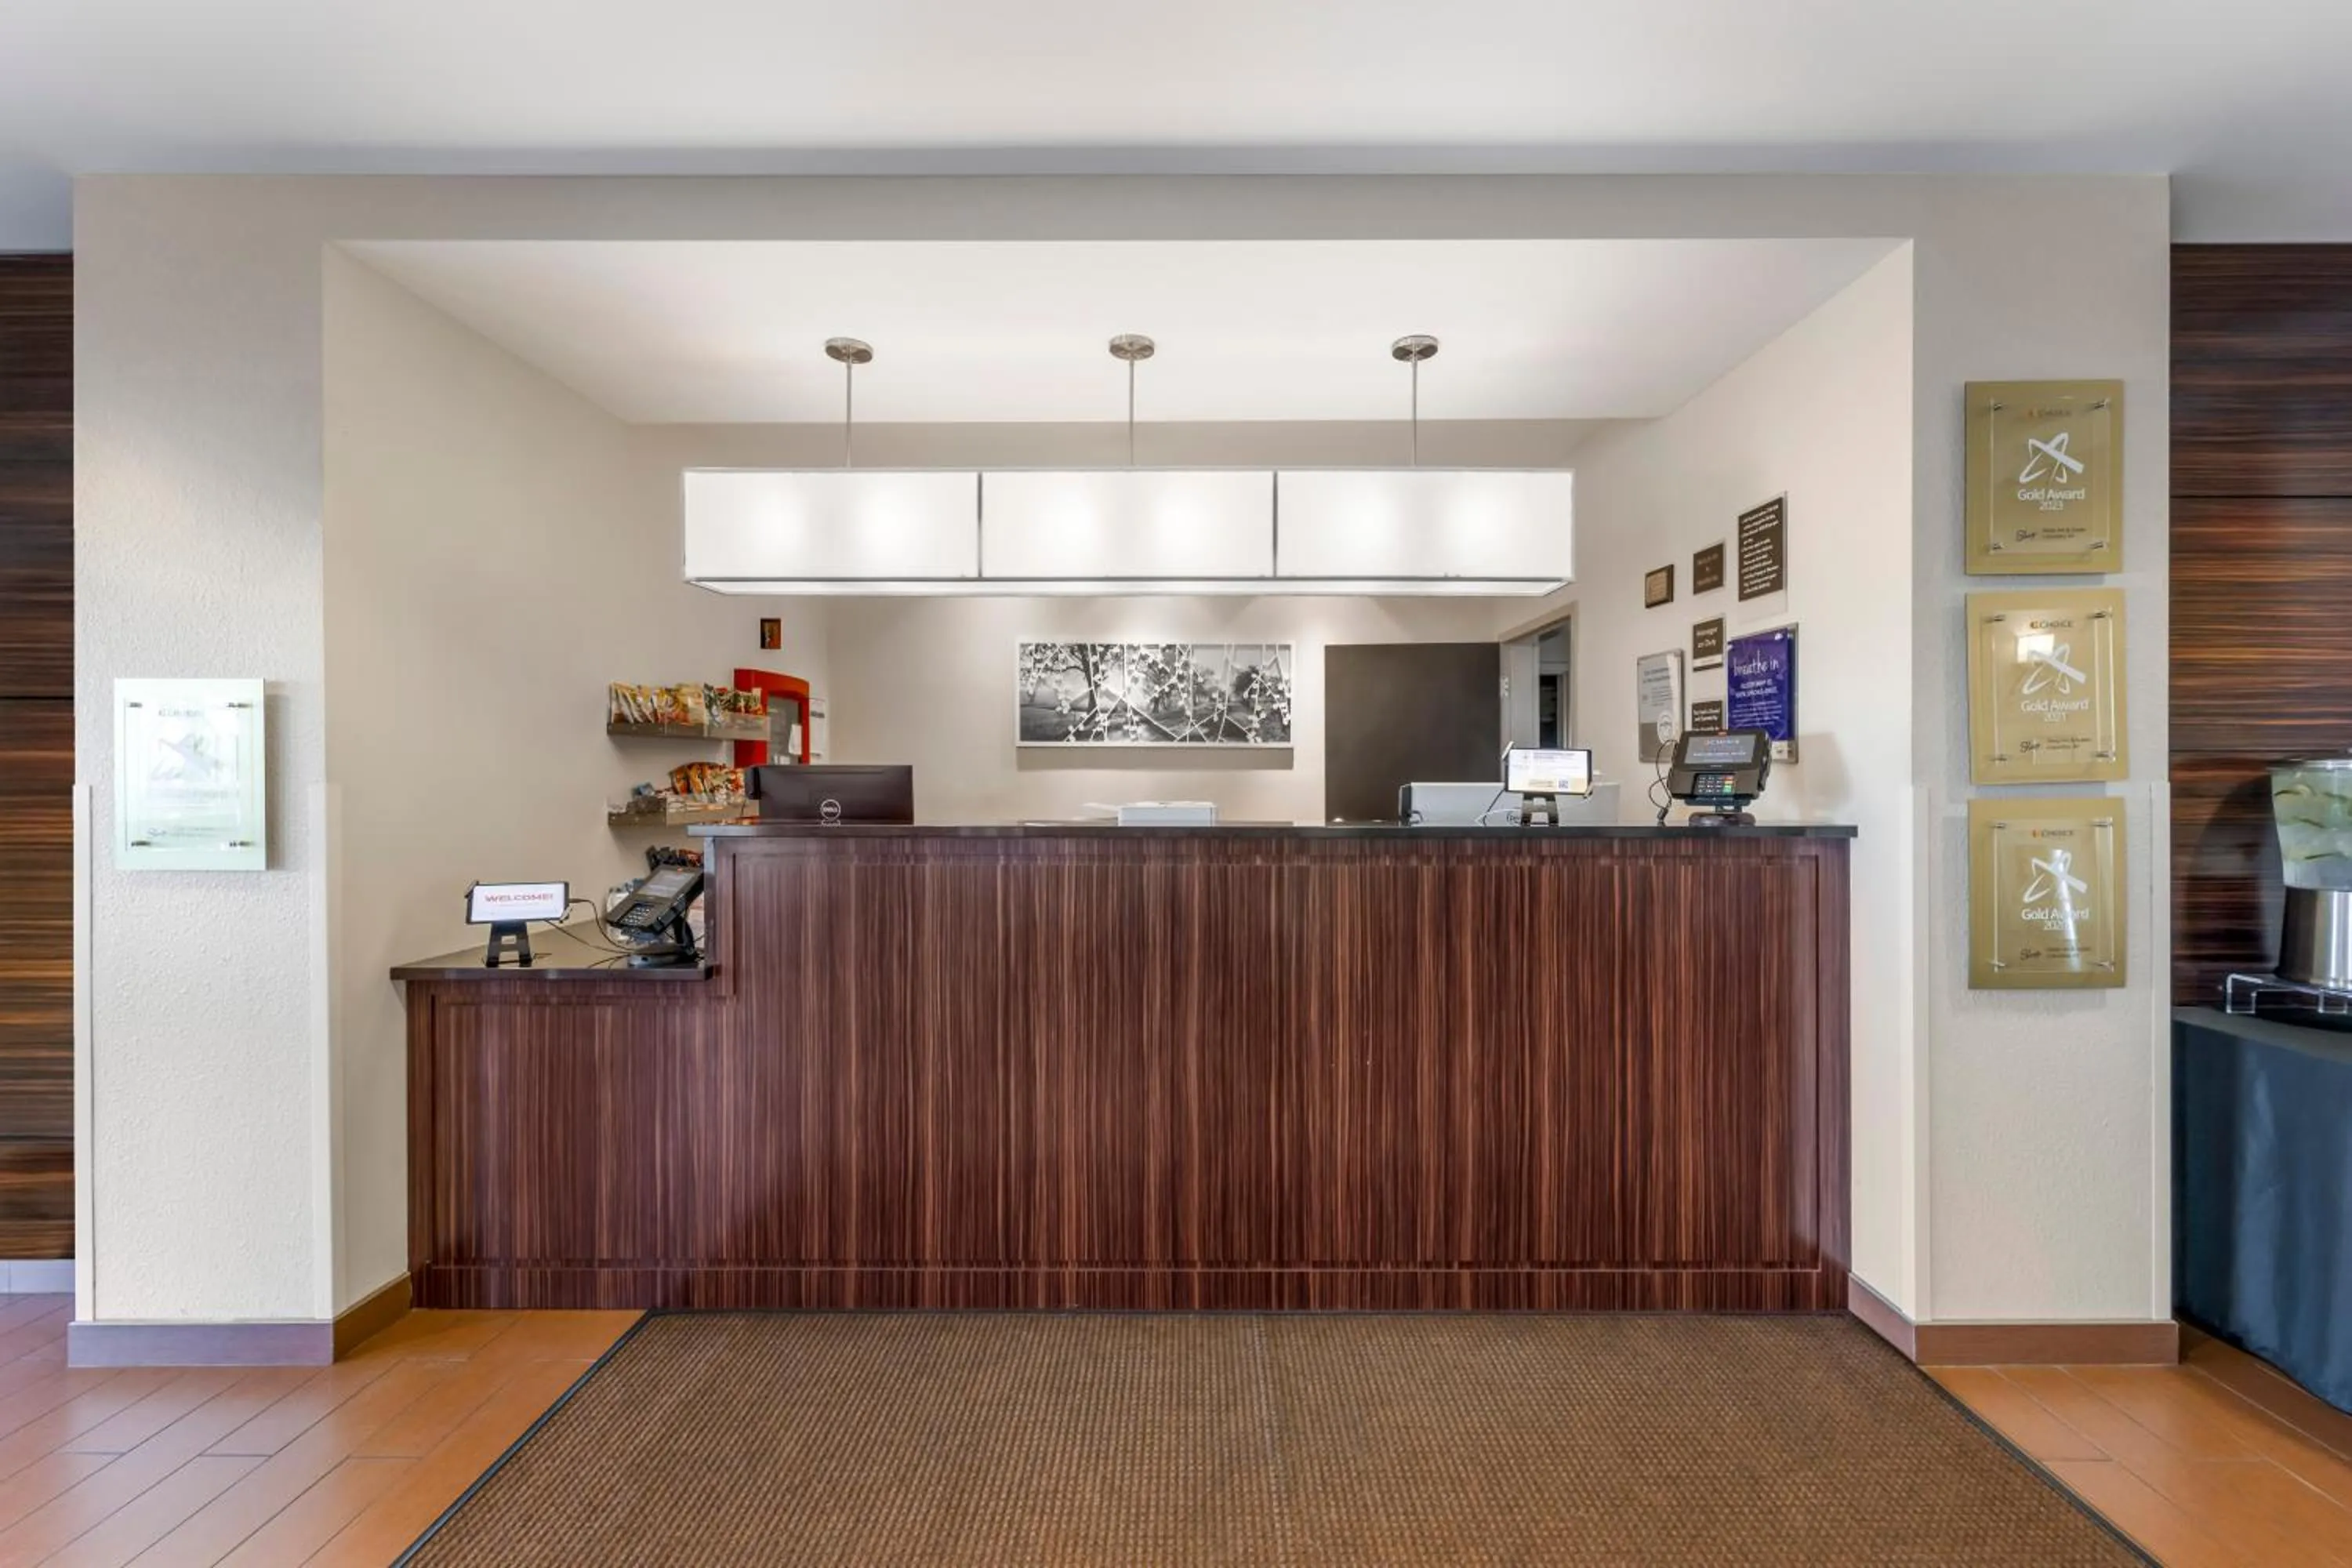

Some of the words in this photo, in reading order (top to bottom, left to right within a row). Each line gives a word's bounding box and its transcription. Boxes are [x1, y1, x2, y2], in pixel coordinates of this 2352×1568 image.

[2018, 488, 2045, 500] Gold
[2047, 488, 2085, 499] Award
[2021, 699, 2048, 712] Gold
[2050, 699, 2089, 711] Award
[485, 893, 553, 902] WELCOME!
[2022, 908, 2048, 920] Gold
[2050, 907, 2089, 920] Ard
